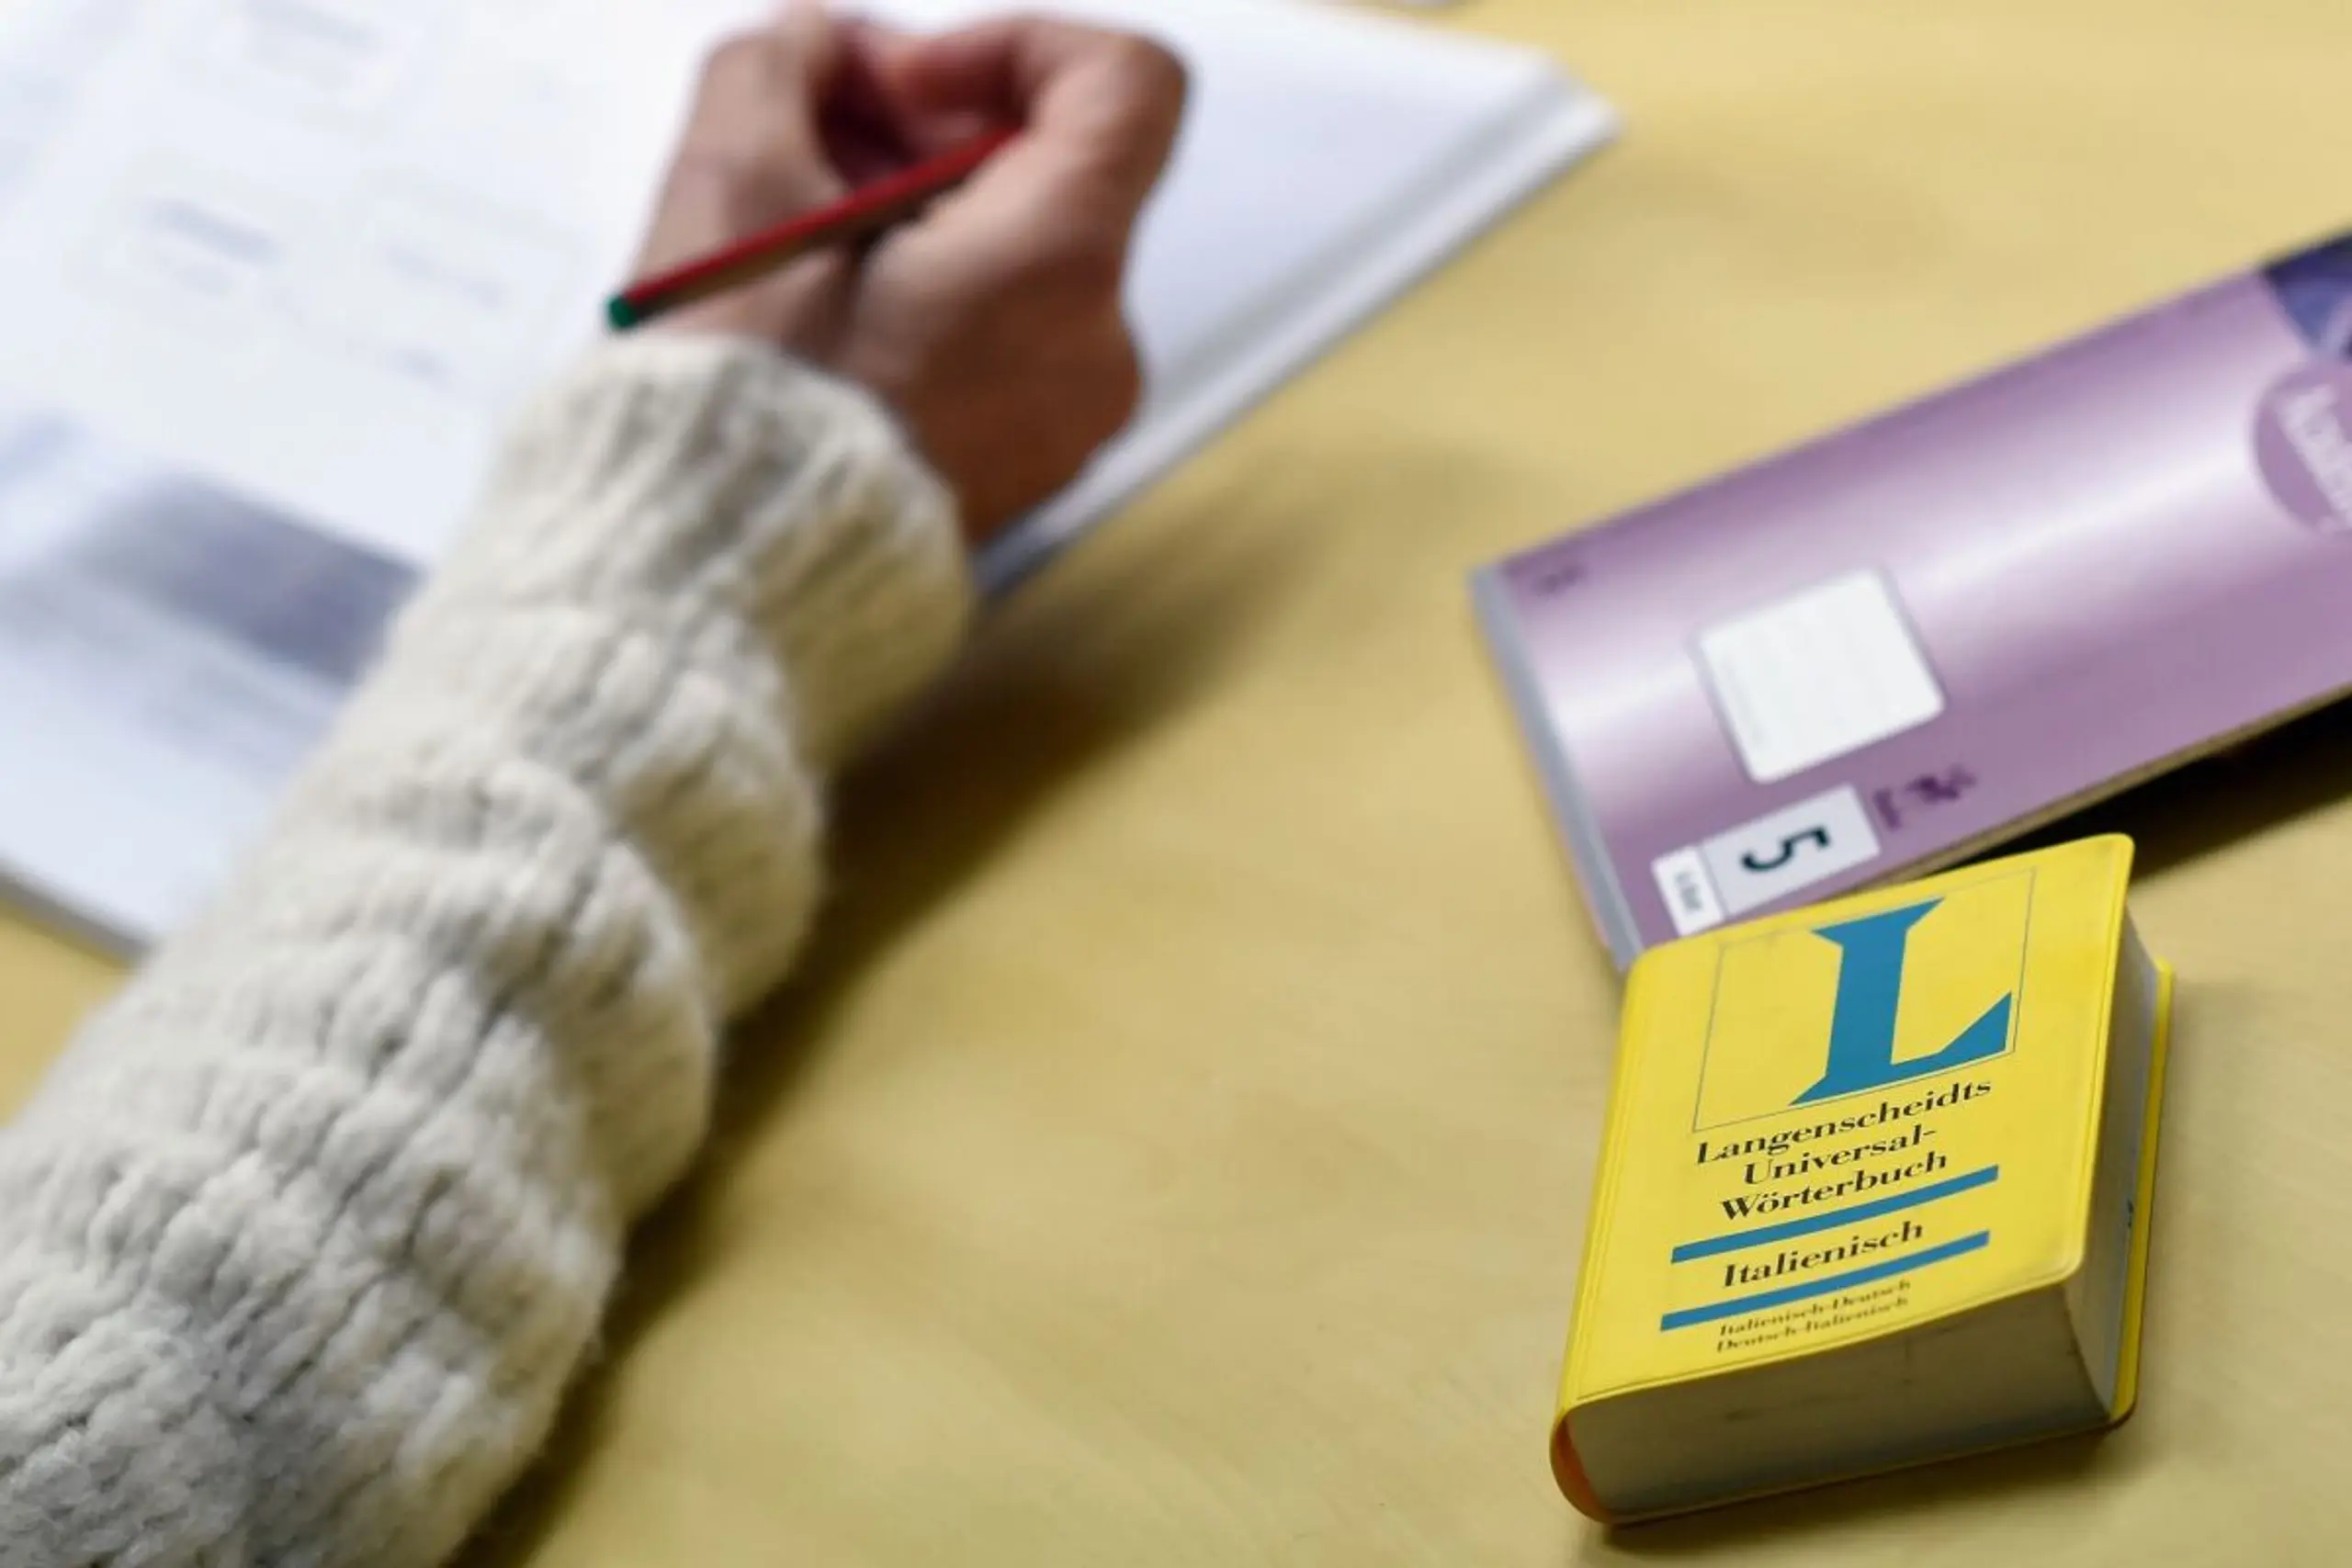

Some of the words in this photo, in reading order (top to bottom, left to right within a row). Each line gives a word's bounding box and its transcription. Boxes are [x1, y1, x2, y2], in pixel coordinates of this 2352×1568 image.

[1740, 825, 1830, 873] 5
[1787, 896, 2012, 1107] L
[1695, 1080, 1992, 1166] Langenscheidts
[1743, 1123, 1938, 1186] Universal-
[1719, 1151, 1948, 1222] Wörterbuch
[1722, 1220, 1924, 1288] Italienisch
[1716, 1296, 1909, 1353] Deutsch-Italienisch
[1719, 1279, 1911, 1337] Italienisch-Deutsch
